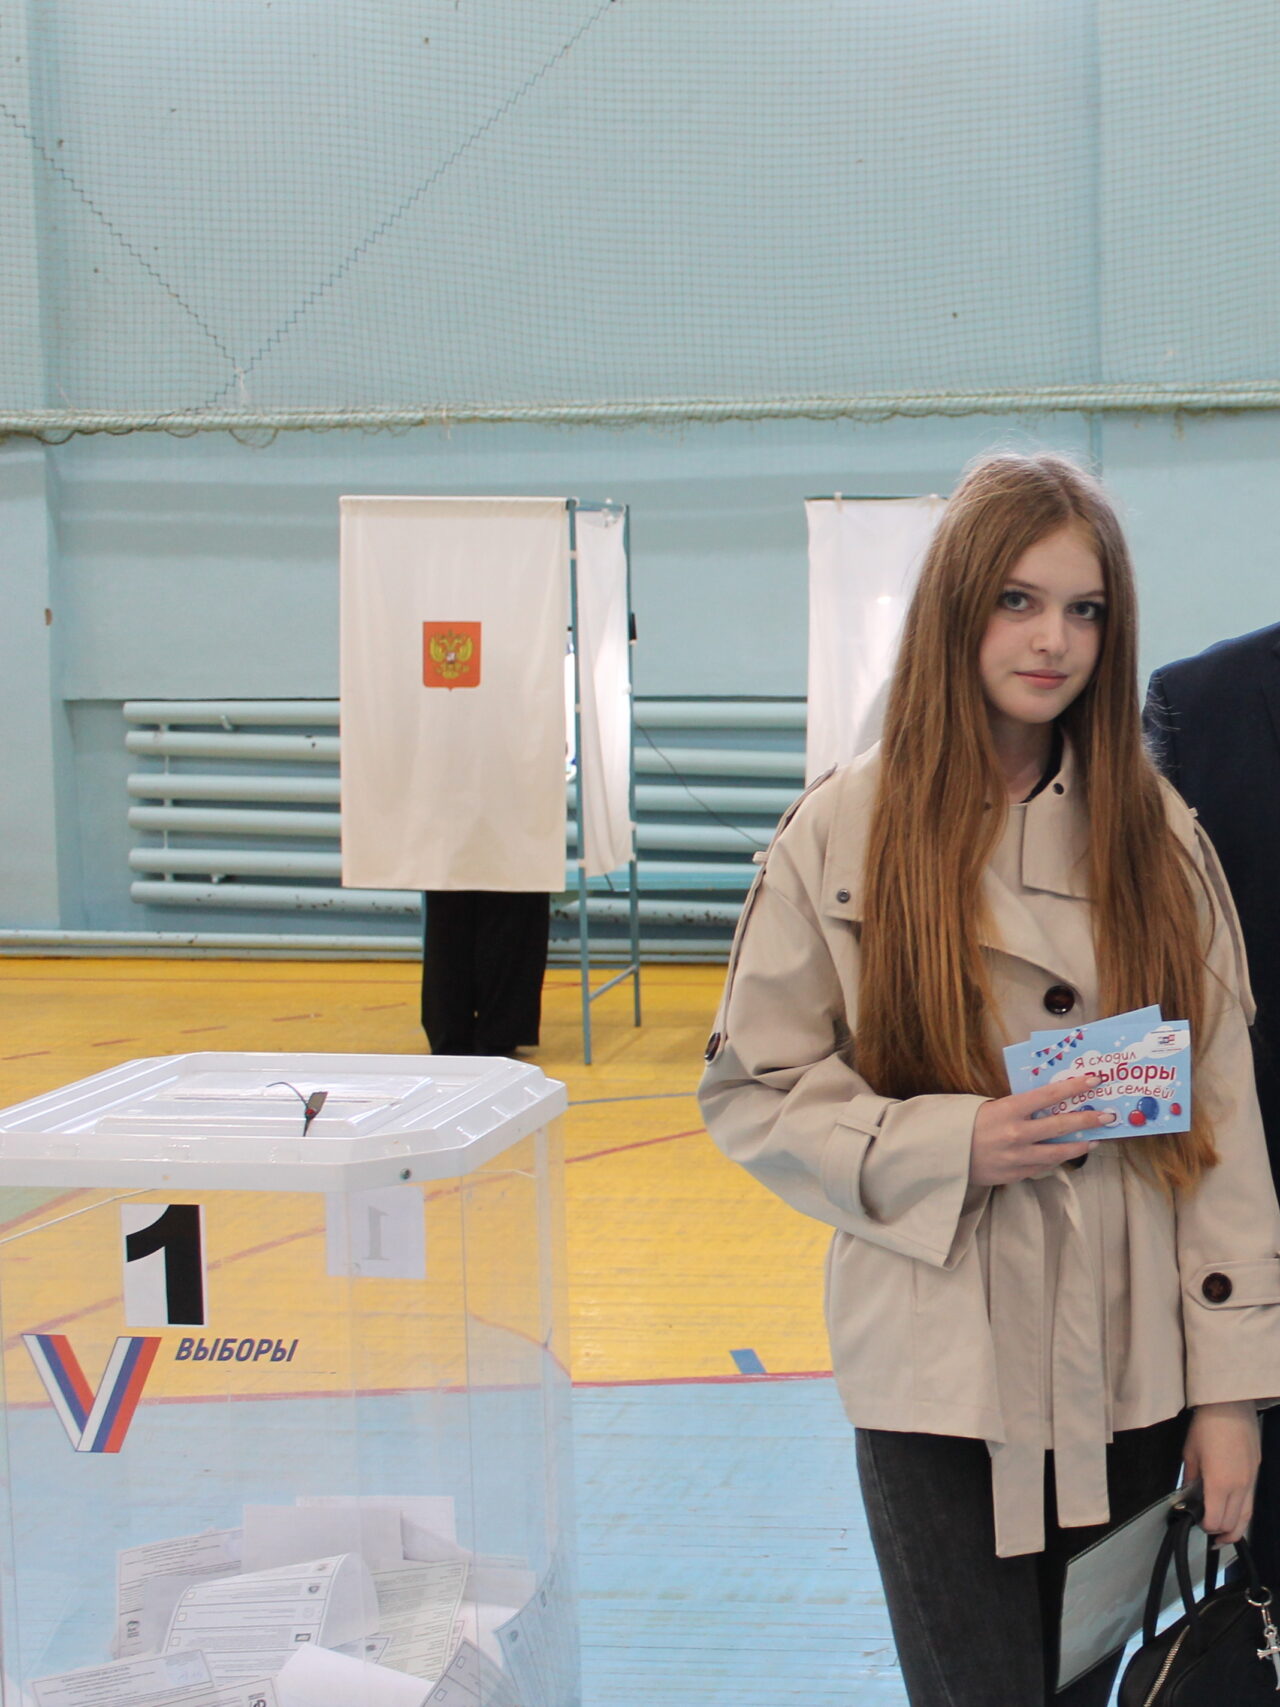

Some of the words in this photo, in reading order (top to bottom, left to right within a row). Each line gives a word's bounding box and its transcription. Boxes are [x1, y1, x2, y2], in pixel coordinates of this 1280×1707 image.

[1074, 1057, 1085, 1070] Я
[1089, 1051, 1137, 1066] сходил
[1051, 1101, 1067, 1115] со
[1071, 1084, 1113, 1105] своей
[126, 1204, 205, 1325] 1
[175, 1337, 299, 1362] ВЫБОРЫ
